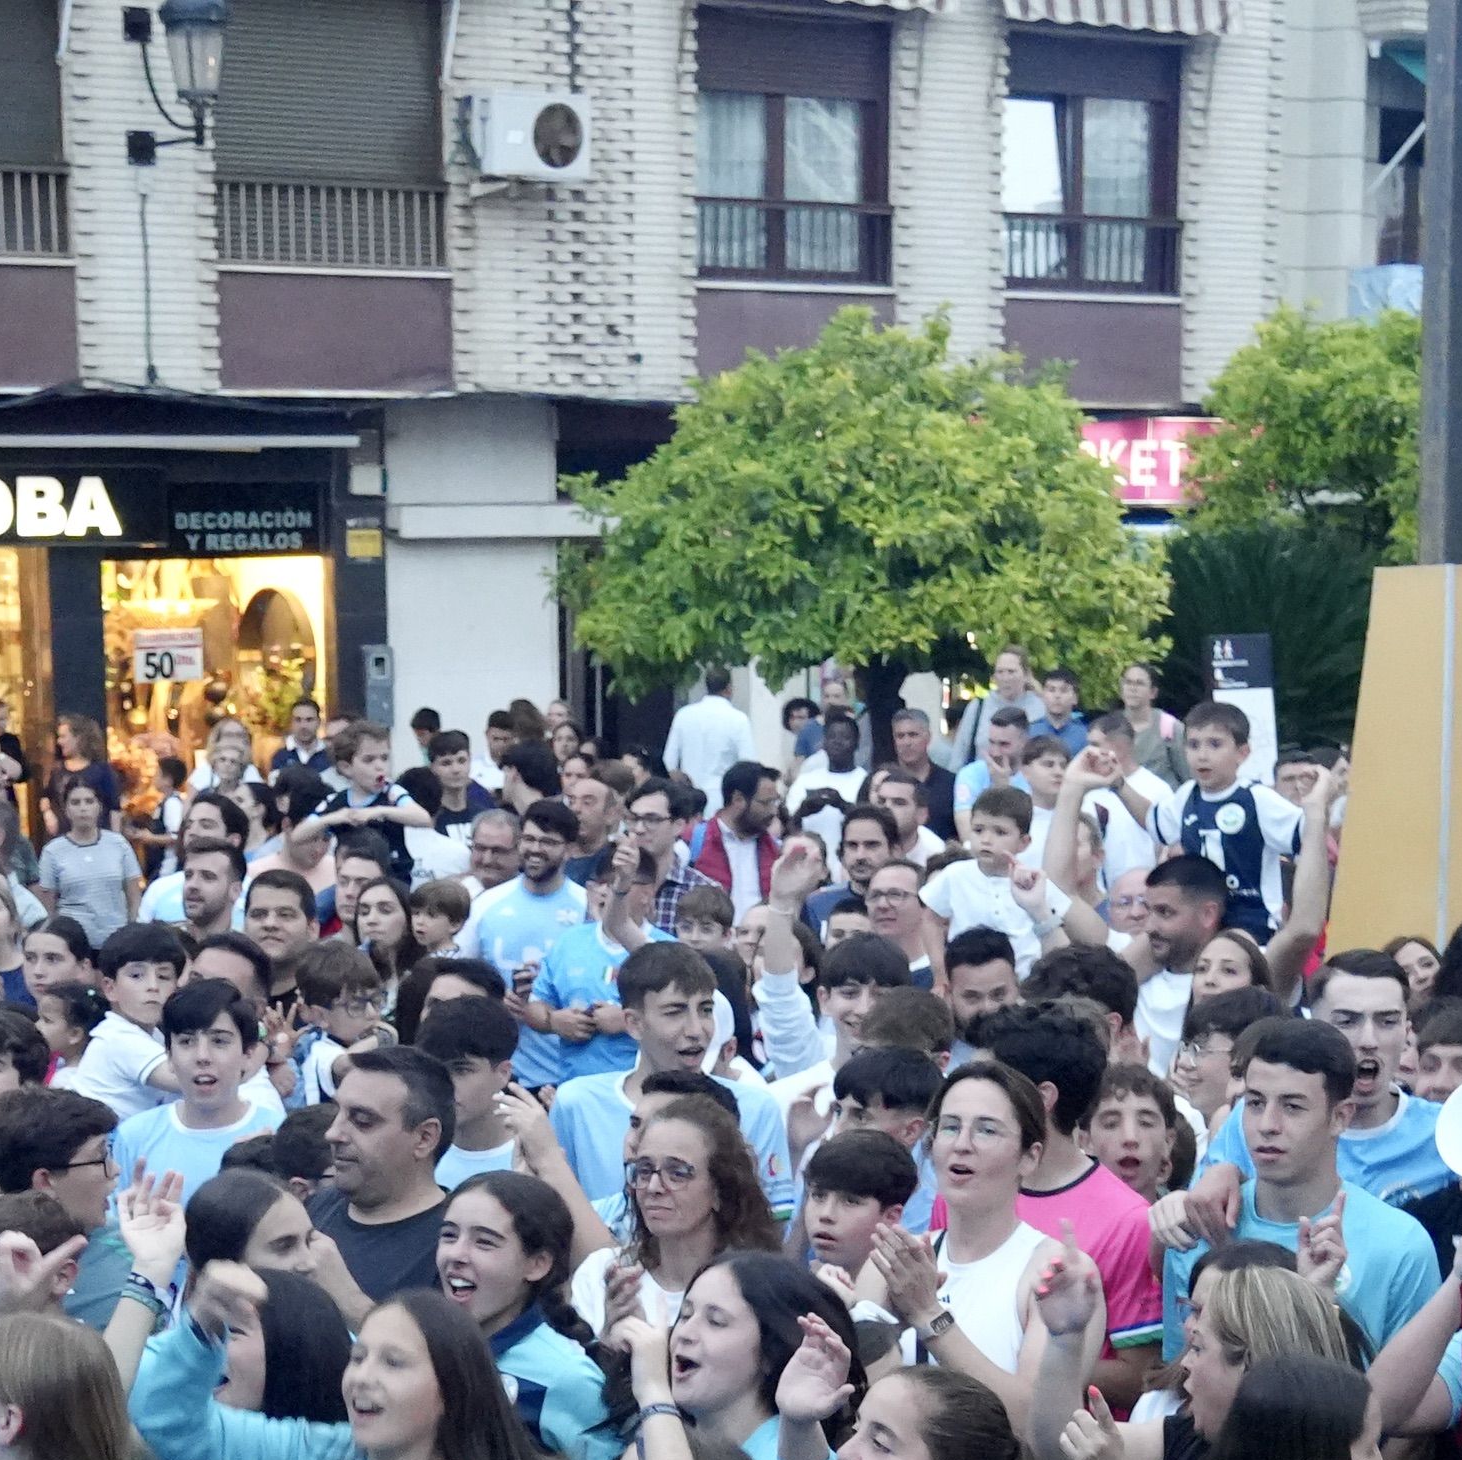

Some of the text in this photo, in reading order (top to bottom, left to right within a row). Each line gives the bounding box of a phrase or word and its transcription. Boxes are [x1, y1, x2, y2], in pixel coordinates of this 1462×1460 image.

[174, 507, 312, 530] DECORACIÓN
[187, 533, 303, 551] Y REGALOS
[144, 651, 174, 679] 50
